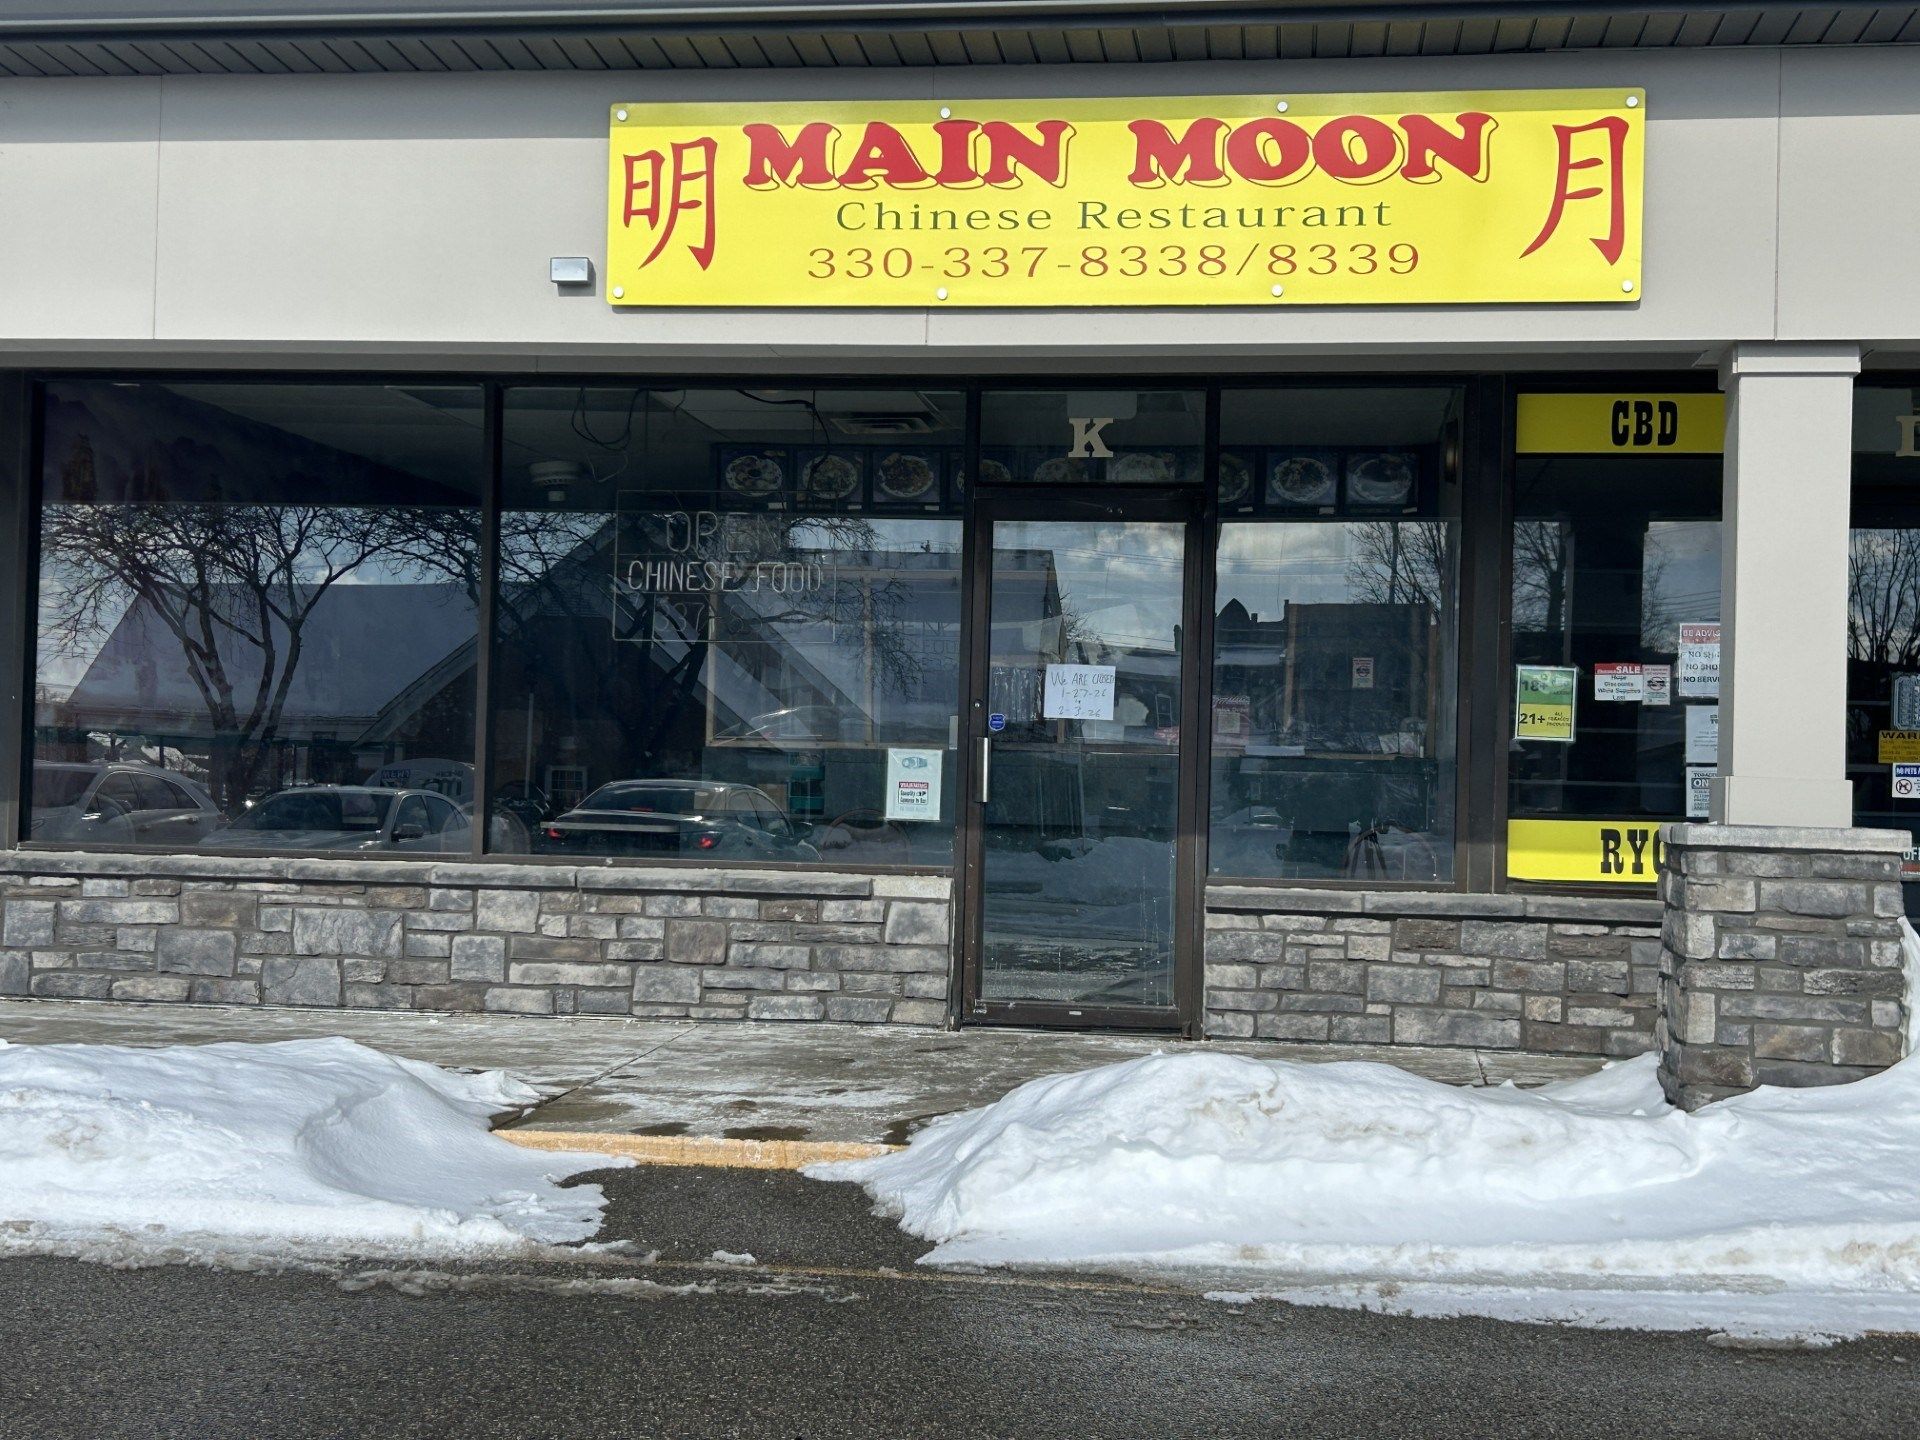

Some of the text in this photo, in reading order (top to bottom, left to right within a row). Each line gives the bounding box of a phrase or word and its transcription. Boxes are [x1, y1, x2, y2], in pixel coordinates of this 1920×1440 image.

[743, 112, 1499, 191] MAIN MOON
[624, 137, 718, 271] 明
[1519, 116, 1629, 265] 月
[837, 201, 1392, 230] Chinese Restaurant
[808, 243, 1419, 279] 330-337-8338/8339
[1068, 418, 1114, 457] K
[1611, 400, 1678, 447] CBD
[666, 511, 781, 553] OPEN
[628, 560, 821, 593] CHINESE FOOD
[1683, 629, 1720, 637] BE ADVIS
[1616, 665, 1641, 674] SALE
[1519, 712, 1546, 725] 21+
[1881, 731, 1920, 740] WAR
[1693, 779, 1709, 788] ON
